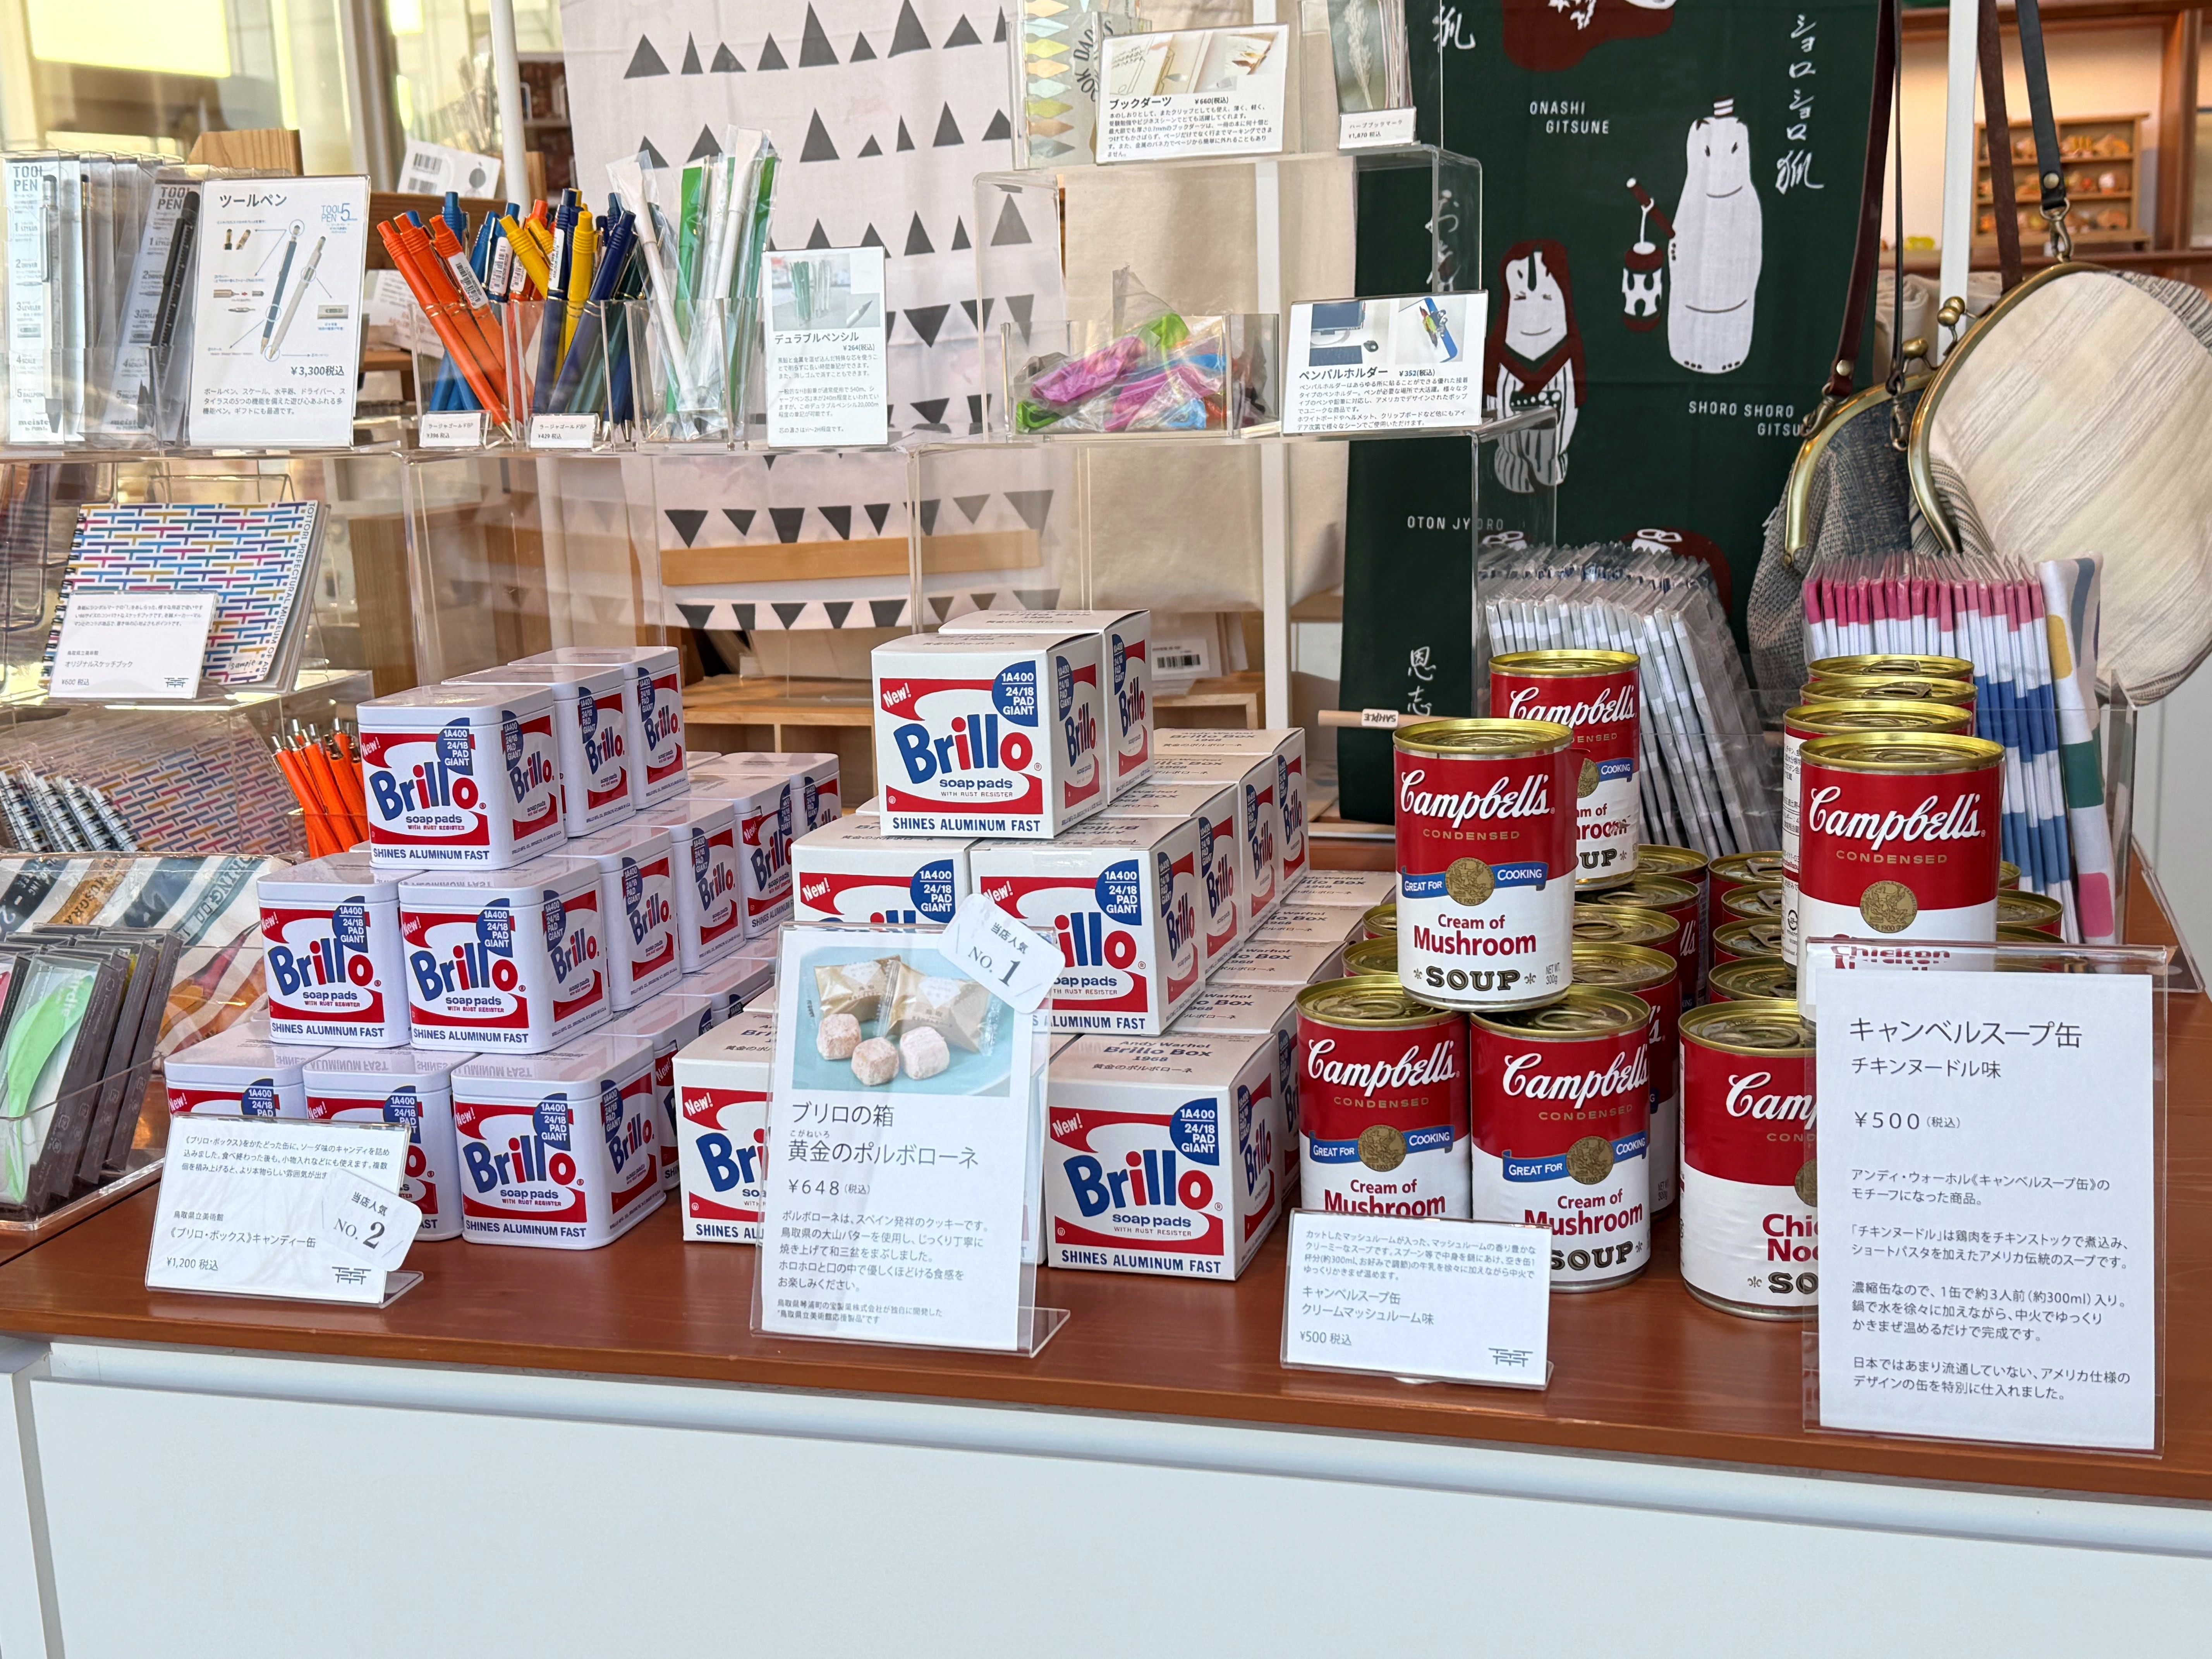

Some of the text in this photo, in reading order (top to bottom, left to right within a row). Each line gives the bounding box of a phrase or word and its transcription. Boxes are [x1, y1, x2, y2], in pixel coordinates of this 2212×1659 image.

[1110, 97, 1171, 110] ブックダーツ
[1530, 101, 1586, 116] ONASHI
[1546, 119, 1610, 135] GITSUNE
[14, 179, 38, 192] PEN
[161, 186, 190, 198] TOO
[157, 199, 182, 210] PEN
[220, 194, 287, 208] ツールペン
[321, 205, 341, 214] TOOL
[321, 214, 337, 222] PEN
[775, 331, 859, 345] デュラブルペンシル
[1299, 366, 1388, 380] ペンパルホルダー
[1689, 400, 1794, 419] SHORO SHORO
[1757, 422, 1802, 436] GITSU
[1407, 515, 1445, 530] OTON
[259, 502, 316, 676] TOTTORI PREFECTURAL MUSEUM OF ART
[1002, 672, 1034, 682] 1A400
[883, 682, 912, 708] New!
[1006, 687, 1034, 696] 24/18
[1003, 706, 1035, 716] GIANT
[1013, 697, 1034, 706] PAD
[1364, 713, 1396, 722] SAMPLE
[893, 713, 1033, 785] Brillo
[369, 762, 479, 821] Brillo
[939, 778, 1013, 790] soap pads
[1401, 769, 1551, 828] Campbell's
[893, 817, 1041, 832] SHINES ALUMINUM FAST
[1809, 786, 1982, 851] Campbell's
[1423, 829, 1520, 840] CONDENSED
[373, 848, 489, 860] SHINES ALUMINUM FAST
[1836, 850, 1948, 864] CONDENSED
[1405, 869, 1542, 891] GREAT FOR COOKING
[65, 872, 105, 925] MUSGRA
[1438, 914, 1506, 930] Cream of
[990, 922, 1029, 955] 当店人気
[1414, 925, 1537, 957] Mushroom
[268, 938, 373, 996] Brillo
[410, 943, 518, 1001] Brillo
[968, 946, 1021, 988] NO. 1
[1425, 965, 1521, 991] SOUP
[1850, 1017, 2083, 1048] キャンベルスープ缶
[1103, 1046, 1212, 1057] Brillo Box
[1307, 1039, 1456, 1097] Campbell's
[1851, 1056, 2002, 1079] チキンヌードル味
[1334, 1097, 1429, 1108] CONDENSED
[792, 1102, 895, 1127] ブリロの箱
[1855, 1111, 1960, 1130] ¥500 (税込)
[789, 1130, 830, 1138] こがねいろ
[787, 1139, 979, 1169] 黄金のポルボローネ
[463, 1135, 577, 1193] Brillo
[788, 1179, 871, 1196] ¥648 (税込)
[1063, 1149, 1213, 1217] Brillo
[1851, 1169, 2111, 1192] アンディ・ウォーホル《キャンベルスープ缶》の
[351, 1192, 388, 1217] 当店人気
[1851, 1187, 1983, 1206] モチーフになった商品。
[173, 1211, 224, 1222] 鳥取県立美術館
[782, 1210, 988, 1232] ポルボローネは、スペイン発祥のクッキーです。
[333, 1218, 385, 1250] NO. 2
[781, 1227, 984, 1248] 鳥取県の大山バターを使用し、じっくり丁寧に
[1851, 1224, 2128, 1250] 「チキンヌードル」は鶏肉をチキンストックで煮込み、
[780, 1243, 933, 1262] 焼き上げて和三盆をまぶしました。
[1062, 1250, 1221, 1274] SHINES ALUMINUM FAST
[1851, 1244, 2128, 1269] ショートパスタを加えたアメリカ伝統のスープです。
[167, 1257, 218, 1271] ¥1,200 税込
[779, 1260, 964, 1281] ホロホロと口の中で優しくほどける食感を
[1304, 1264, 1399, 1281] ゆっくりかきまぜ温めます。
[778, 1277, 860, 1292] お楽しみください。
[1302, 1286, 1401, 1305] キャンベルスープ缶
[1302, 1303, 1434, 1325] クリームマッシュルーム味
[1851, 1300, 2102, 1325] 鍋で水を徐々に加えながら、中火でゆっくり
[1300, 1331, 1352, 1346] ¥500 税込
[1852, 1320, 2042, 1342] かきまぜ温めるだけで完成です。
[1854, 1356, 2130, 1384] 日本ではあまり流通していない、アメリカ仕様の
[1854, 1376, 2066, 1401] デザインの缶を特別に仕入れました。
